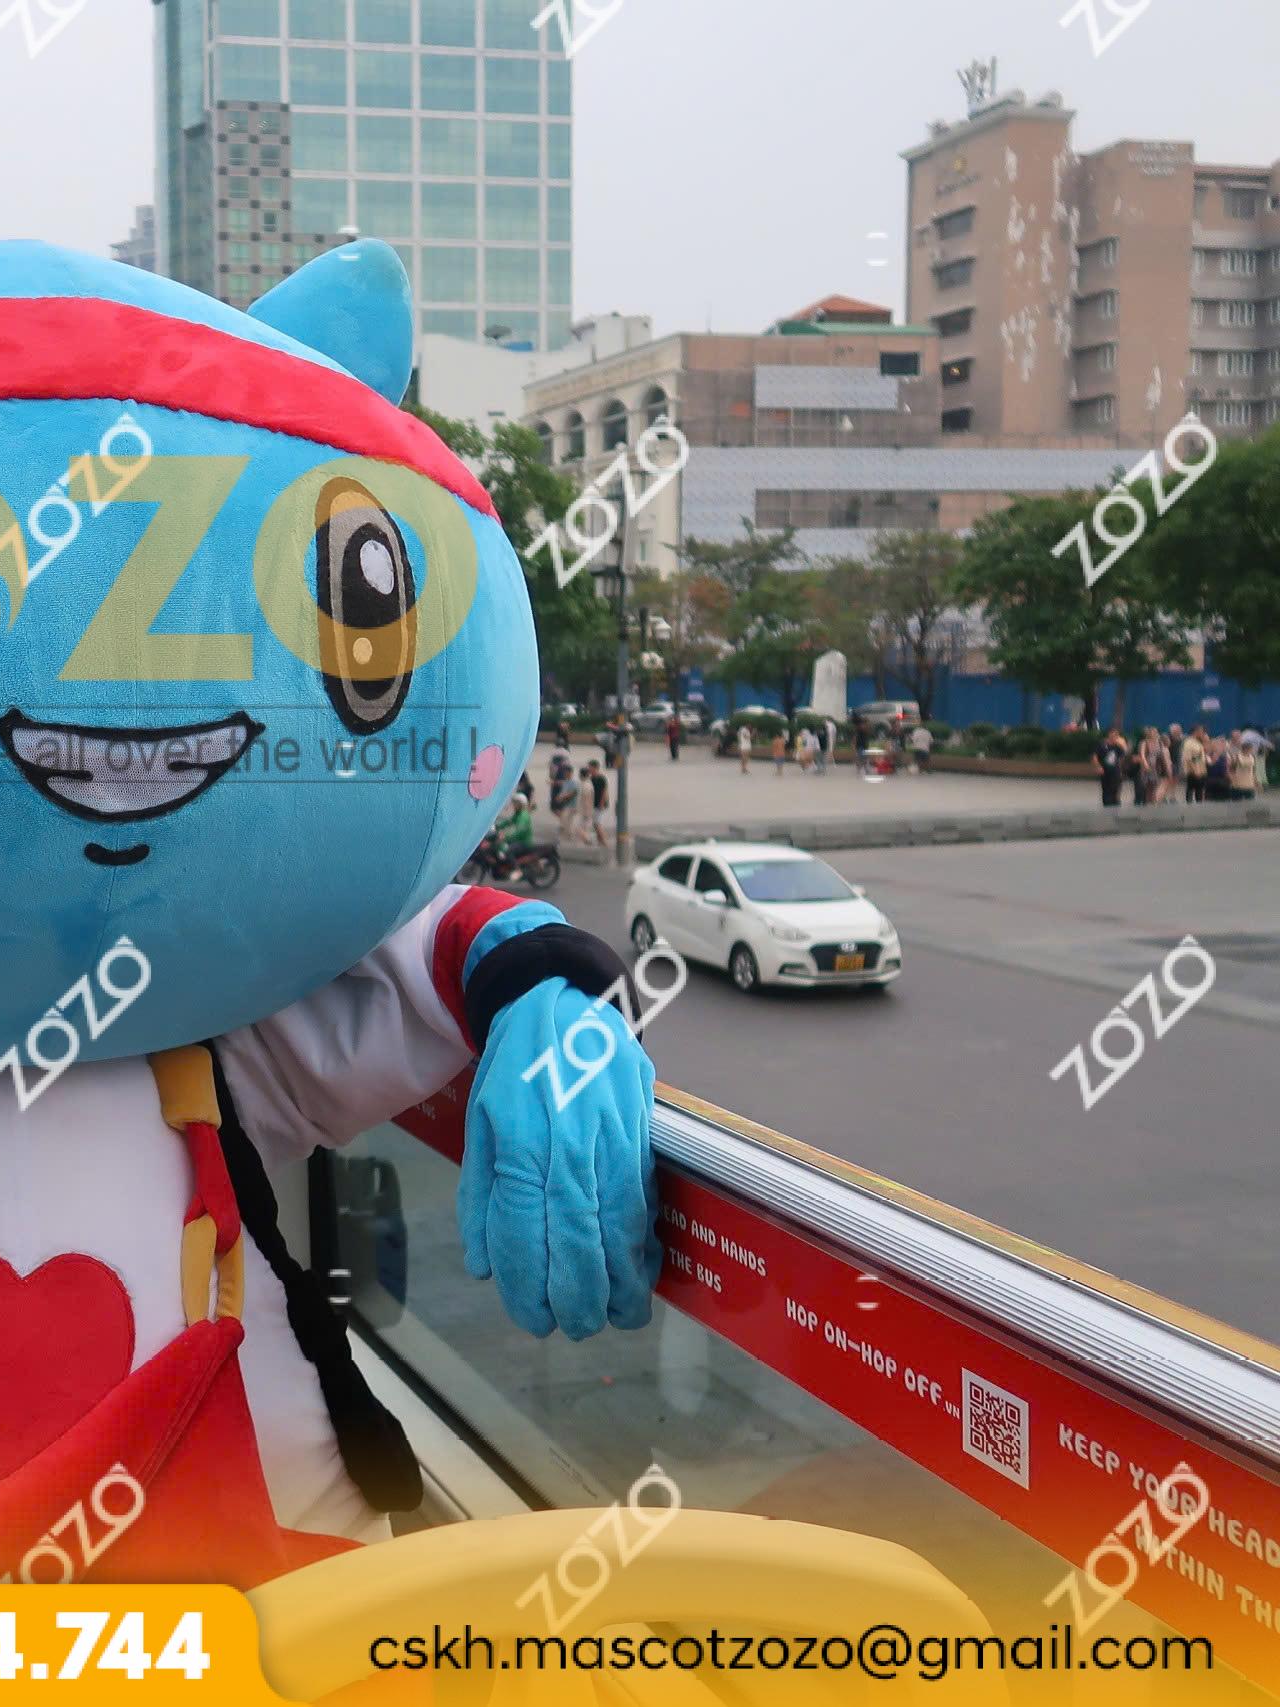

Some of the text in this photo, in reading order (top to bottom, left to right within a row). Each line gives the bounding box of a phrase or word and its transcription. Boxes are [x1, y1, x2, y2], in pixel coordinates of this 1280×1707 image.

[663, 1202, 767, 1277] EAD AND HANDS
[669, 1247, 722, 1294] THE BUS
[786, 1297, 818, 1332] HOP
[1058, 1423, 1120, 1475] KEEP
